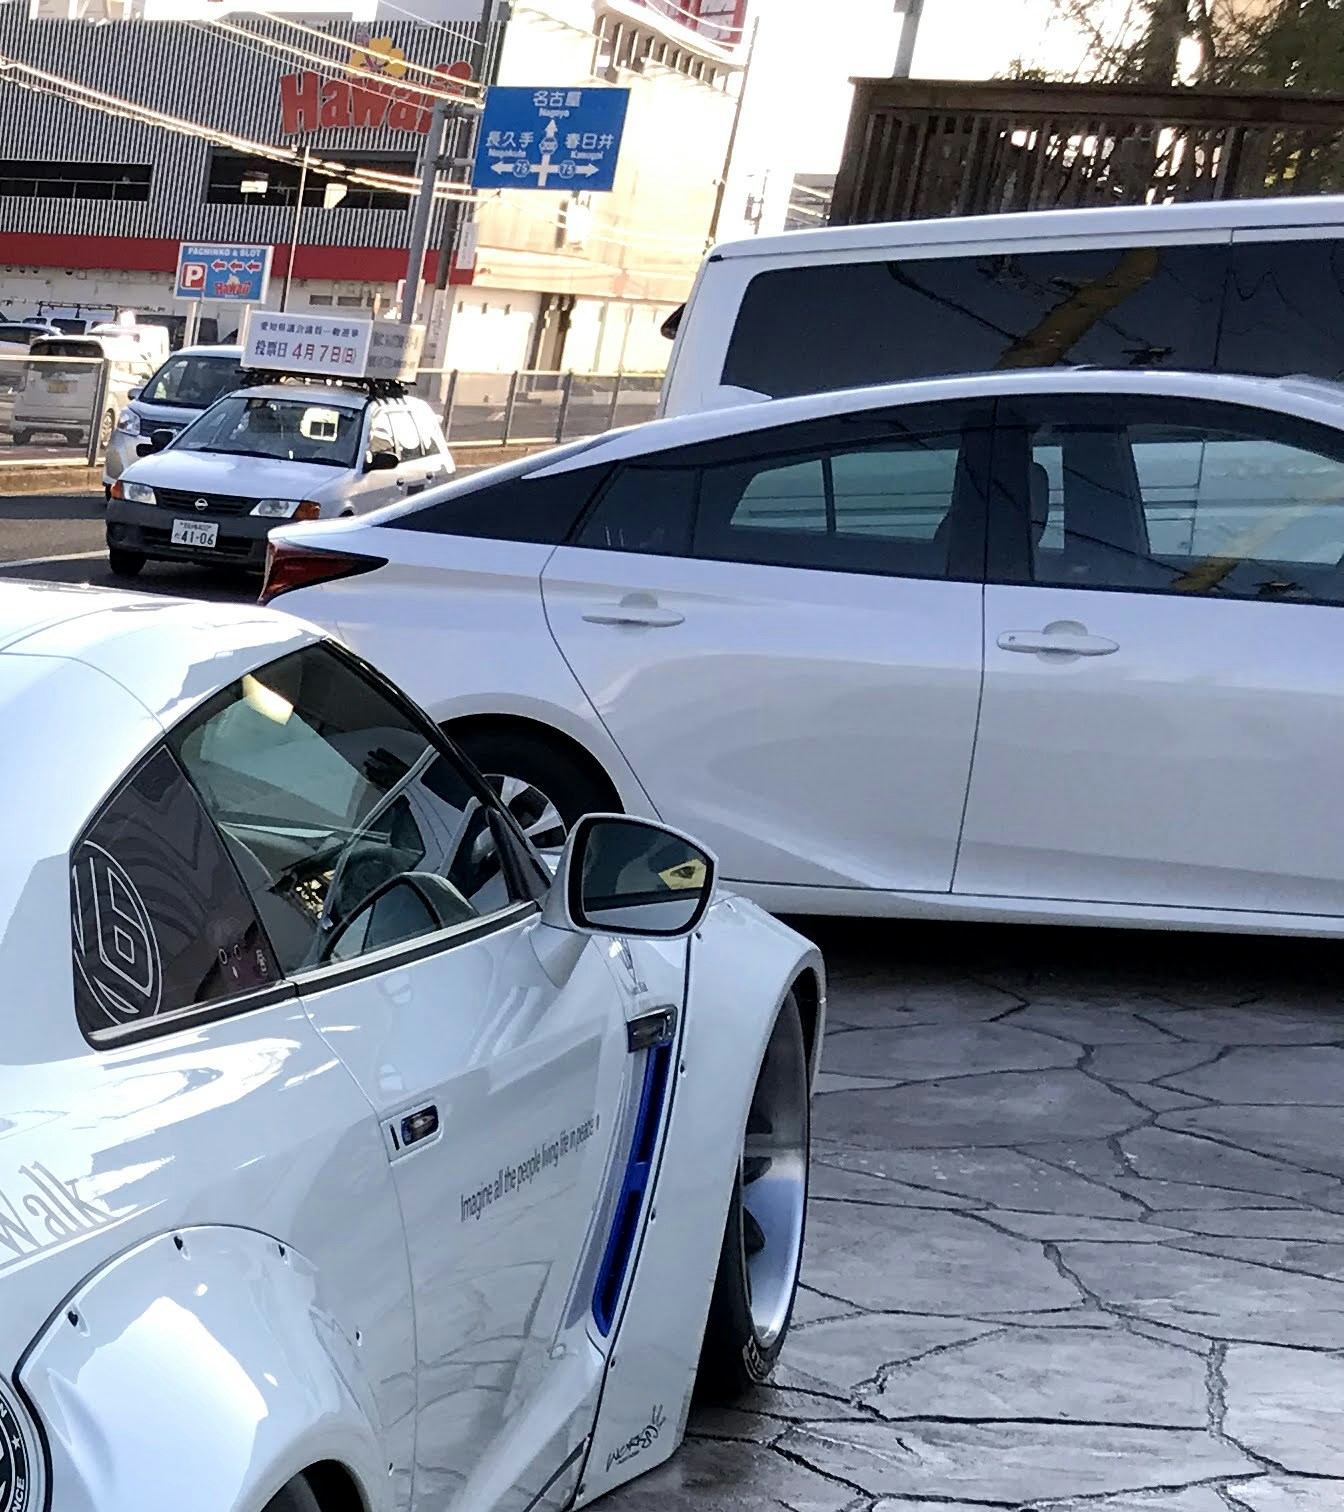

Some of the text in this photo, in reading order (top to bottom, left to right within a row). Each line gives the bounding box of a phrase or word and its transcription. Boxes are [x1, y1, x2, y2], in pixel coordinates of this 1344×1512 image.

[280, 68, 457, 135] Hawai
[533, 91, 582, 107] 名古屋
[486, 131, 534, 148] 長久手
[565, 133, 614, 149] 春日井
[188, 247, 230, 256] PACHINKO
[240, 249, 262, 257] SLOT
[184, 265, 204, 286] P
[255, 340, 288, 358] 投票日
